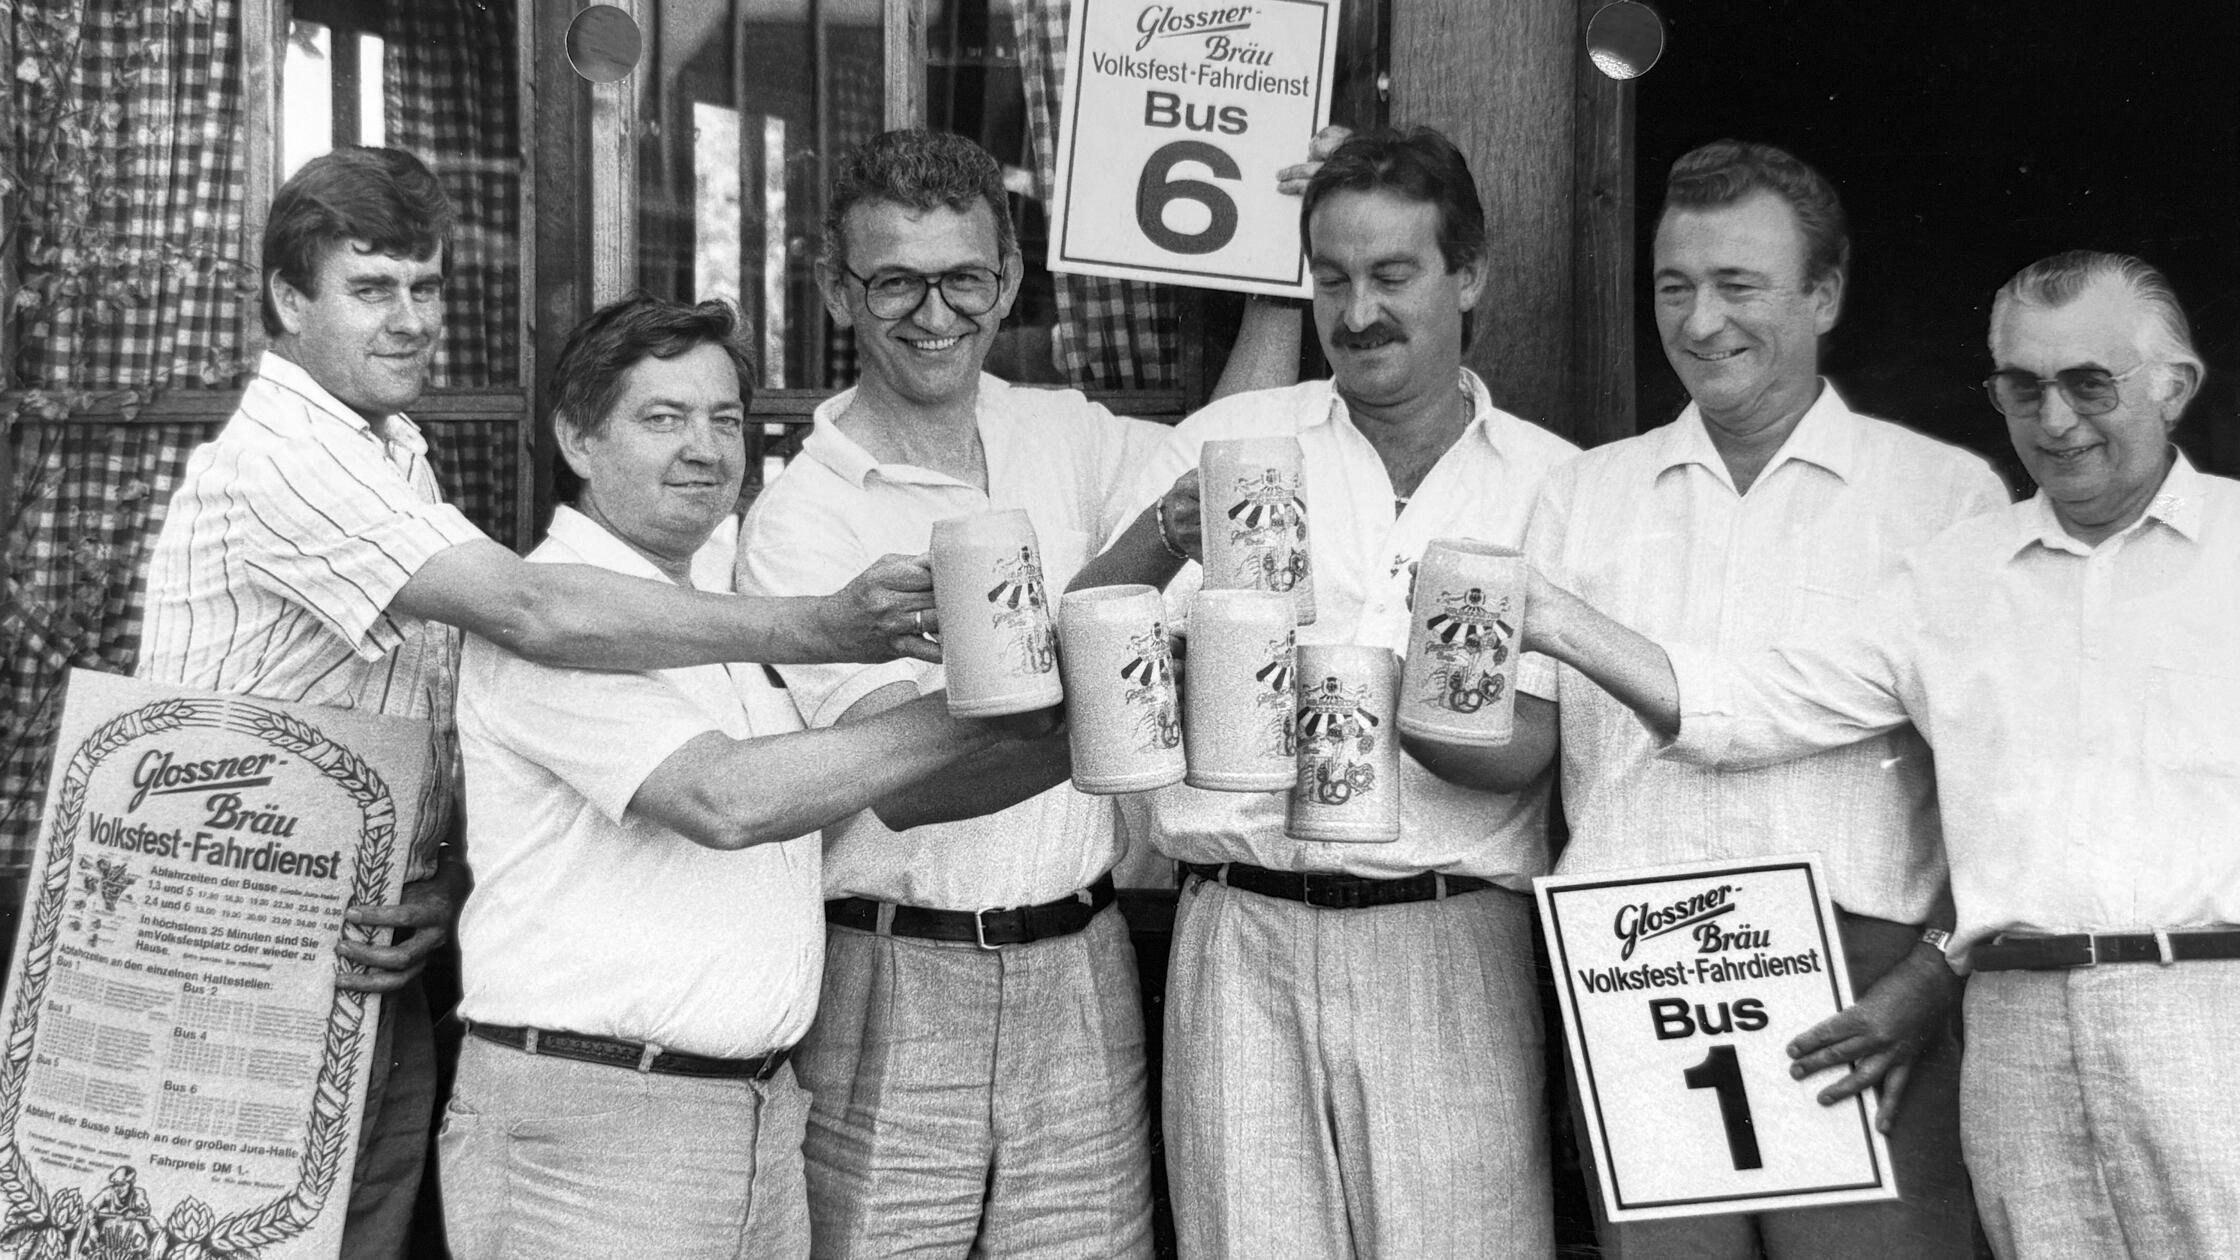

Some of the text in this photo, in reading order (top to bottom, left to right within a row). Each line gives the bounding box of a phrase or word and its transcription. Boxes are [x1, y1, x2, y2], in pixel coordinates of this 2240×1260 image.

[1205, 35, 1274, 66] Bräu
[1092, 51, 1310, 97] Volksfest-Fahrdienst
[1144, 90, 1248, 135] Bus
[1135, 140, 1242, 255] 6
[205, 792, 299, 838] Bräu
[88, 812, 341, 880] Volksfest-Fahrdienst
[151, 866, 218, 885] Abfahrzeiten
[220, 877, 240, 888] der
[242, 879, 278, 893] Busse
[164, 883, 183, 895] und
[187, 886, 194, 896] 5
[161, 899, 181, 911] und
[183, 901, 191, 912] 6
[140, 914, 150, 925] In
[210, 926, 224, 937] 25
[226, 928, 272, 943] Minuten
[274, 935, 298, 947] sind
[301, 937, 319, 949] Sie
[1693, 920, 1771, 954] Bräu
[56, 954, 72, 968] Bus
[234, 942, 259, 955] oder
[262, 946, 300, 959] wieder
[302, 952, 316, 961] zu
[110, 958, 123, 968] an
[124, 960, 142, 971] den
[147, 964, 199, 981] einzelnen
[1578, 948, 1821, 994] Volksfest-Fahrdienst
[183, 981, 218, 996] Bus 2
[174, 1026, 207, 1041] Bus 4
[1649, 997, 1769, 1040] Bus
[164, 1079, 198, 1094] Bus 6
[1683, 1044, 1763, 1170] 1
[26, 1104, 299, 1159] Abfahrt aller Busse täglich an der großen Jura-Halle
[150, 1153, 206, 1171] Fahrpreis
[212, 1162, 232, 1174] DM
